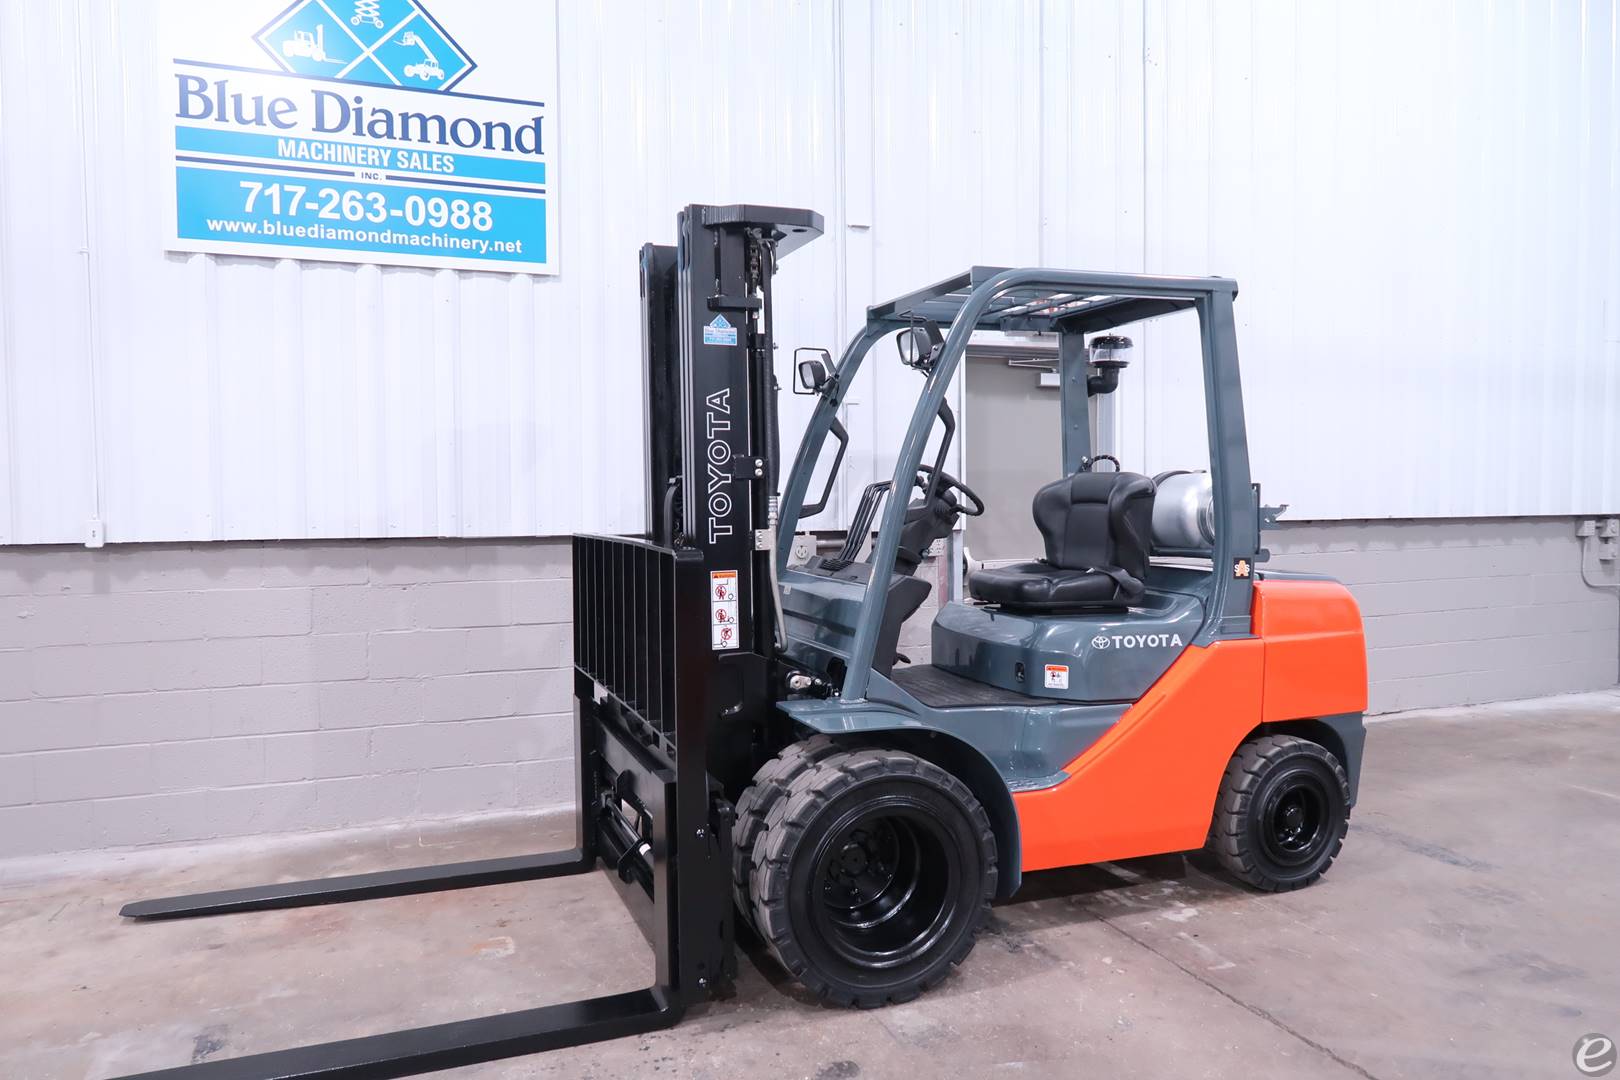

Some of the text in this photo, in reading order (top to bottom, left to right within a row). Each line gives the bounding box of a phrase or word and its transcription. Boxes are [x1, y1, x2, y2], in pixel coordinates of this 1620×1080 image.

[175, 73, 545, 155] Blue Diamond
[278, 138, 455, 173] MACHINERY SALES
[361, 172, 382, 181] INC.
[239, 181, 493, 231] 717-263-0988
[207, 217, 523, 254] www.bluediamondmachinery.net
[706, 387, 733, 544] TOYOTA
[1112, 633, 1183, 649] TOYOTA
